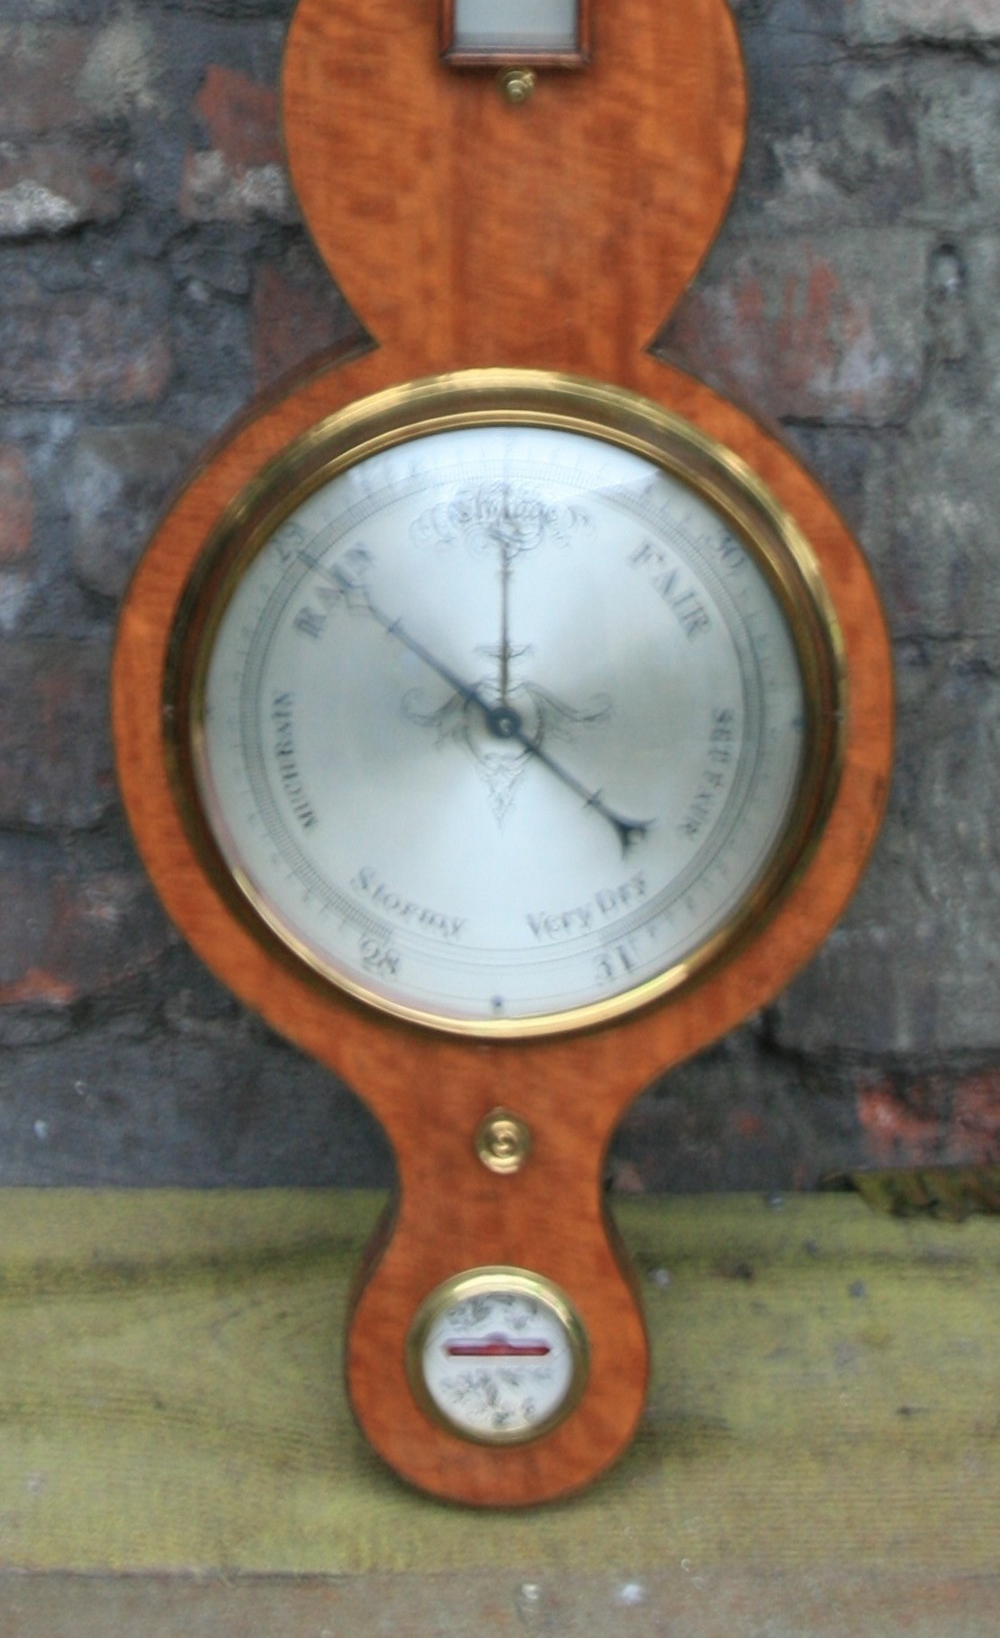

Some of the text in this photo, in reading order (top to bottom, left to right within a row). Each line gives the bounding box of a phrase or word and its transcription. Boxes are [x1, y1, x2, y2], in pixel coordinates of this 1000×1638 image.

[628, 540, 711, 642] FAIR
[271, 691, 296, 758] RAIN
[349, 866, 470, 942] Stormy
